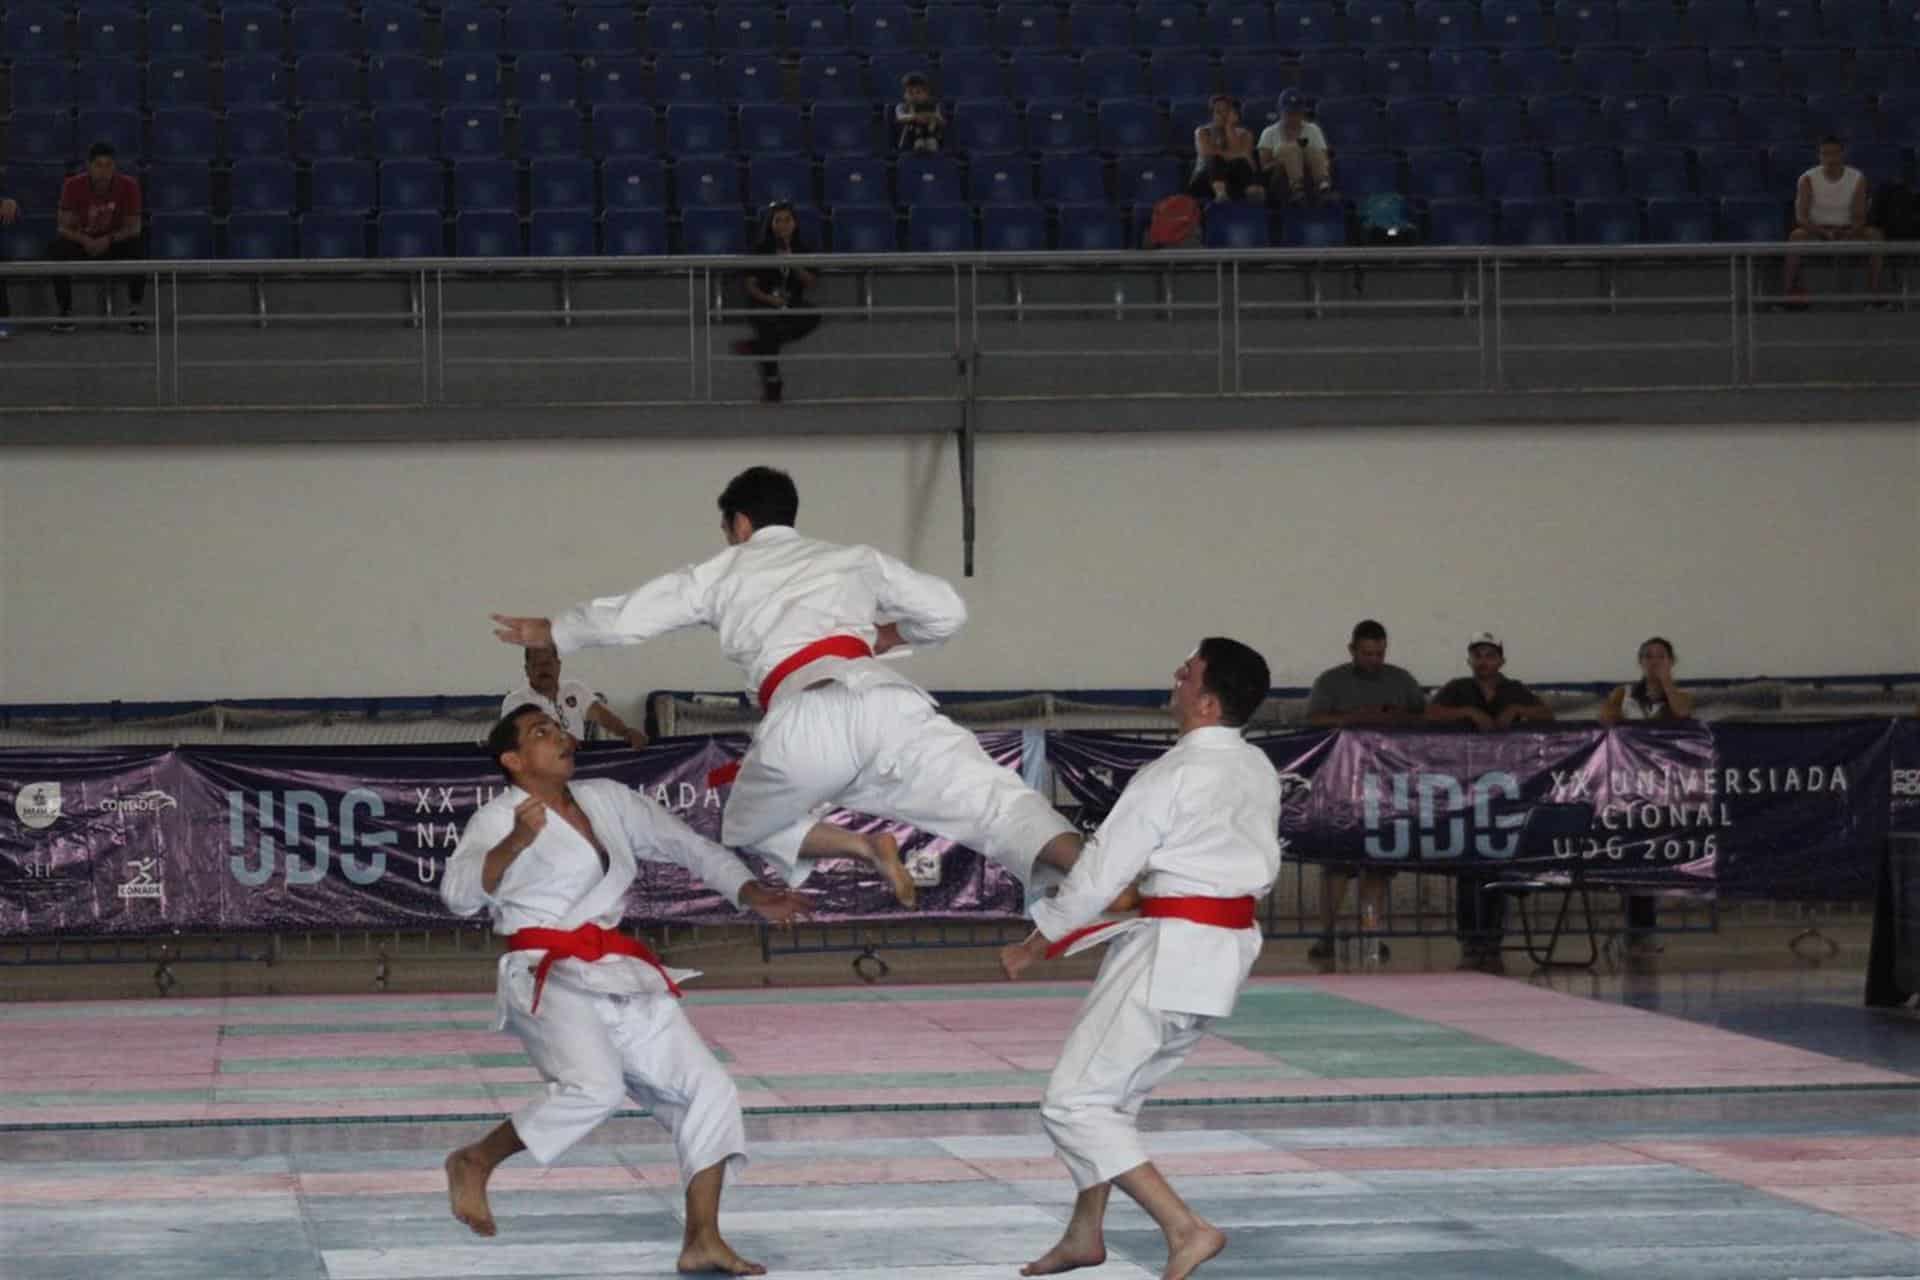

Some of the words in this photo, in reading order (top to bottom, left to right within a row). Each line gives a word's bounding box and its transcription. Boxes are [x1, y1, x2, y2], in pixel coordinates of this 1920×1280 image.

[1610, 766, 1848, 796] UNIVERSIADA
[415, 787, 455, 813] XX
[1591, 802, 1733, 830] CIONAL
[1643, 834, 1718, 860] 2016
